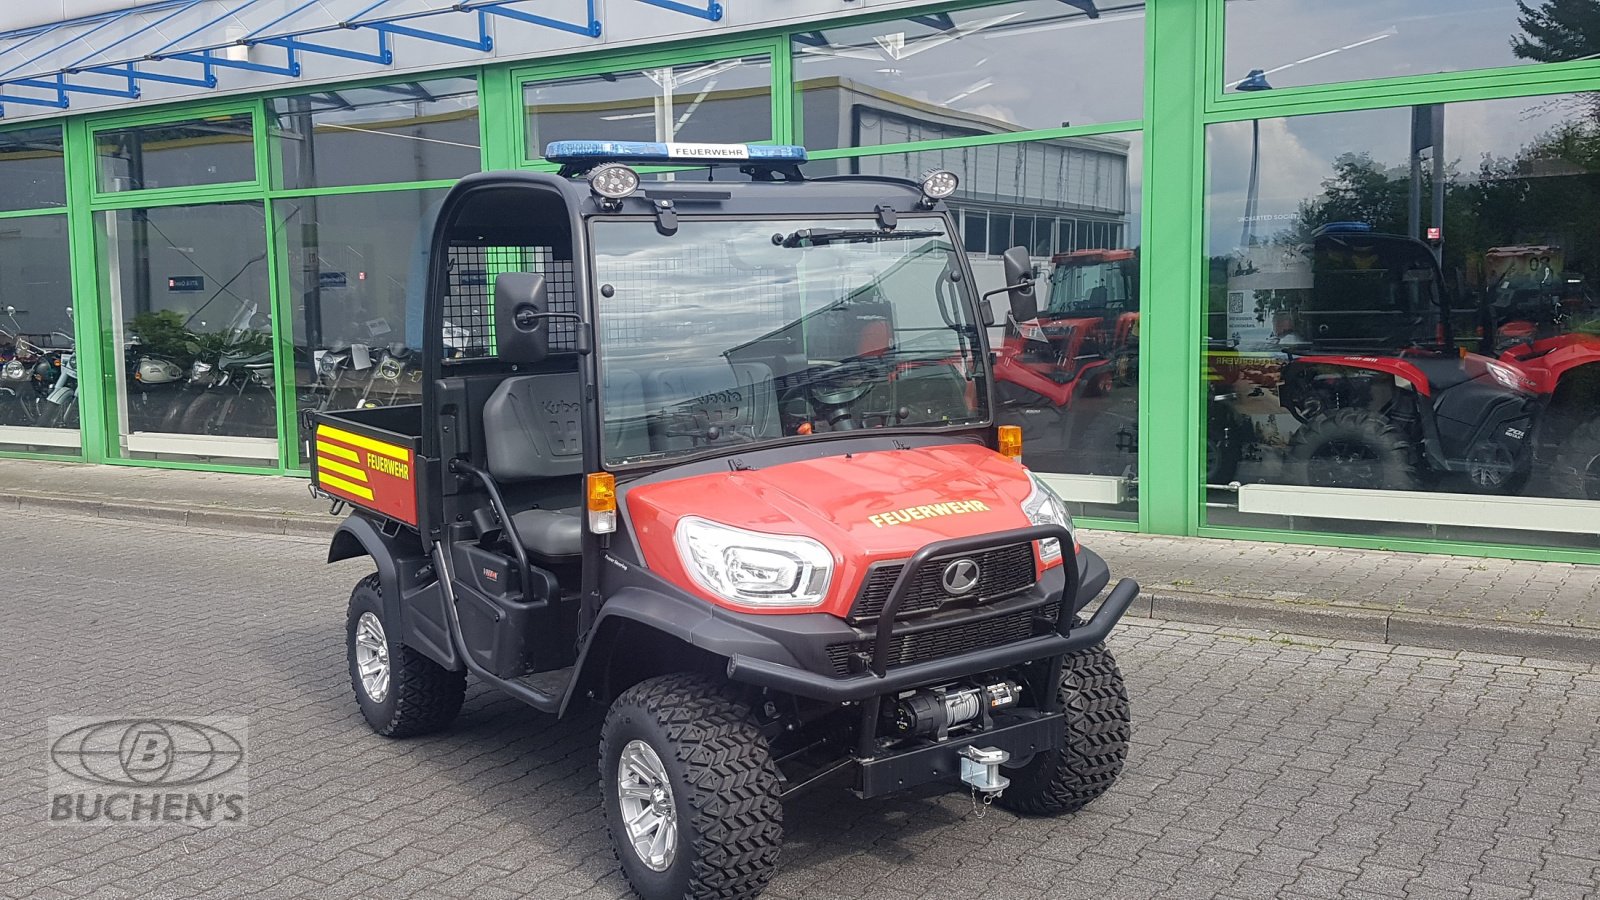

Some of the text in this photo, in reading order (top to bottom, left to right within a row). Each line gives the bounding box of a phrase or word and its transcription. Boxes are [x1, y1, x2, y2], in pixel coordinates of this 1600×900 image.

[675, 148, 744, 156] FEUERWEHR
[366, 452, 409, 480] FEUERWEHR
[867, 499, 992, 529] FEUERWEHR
